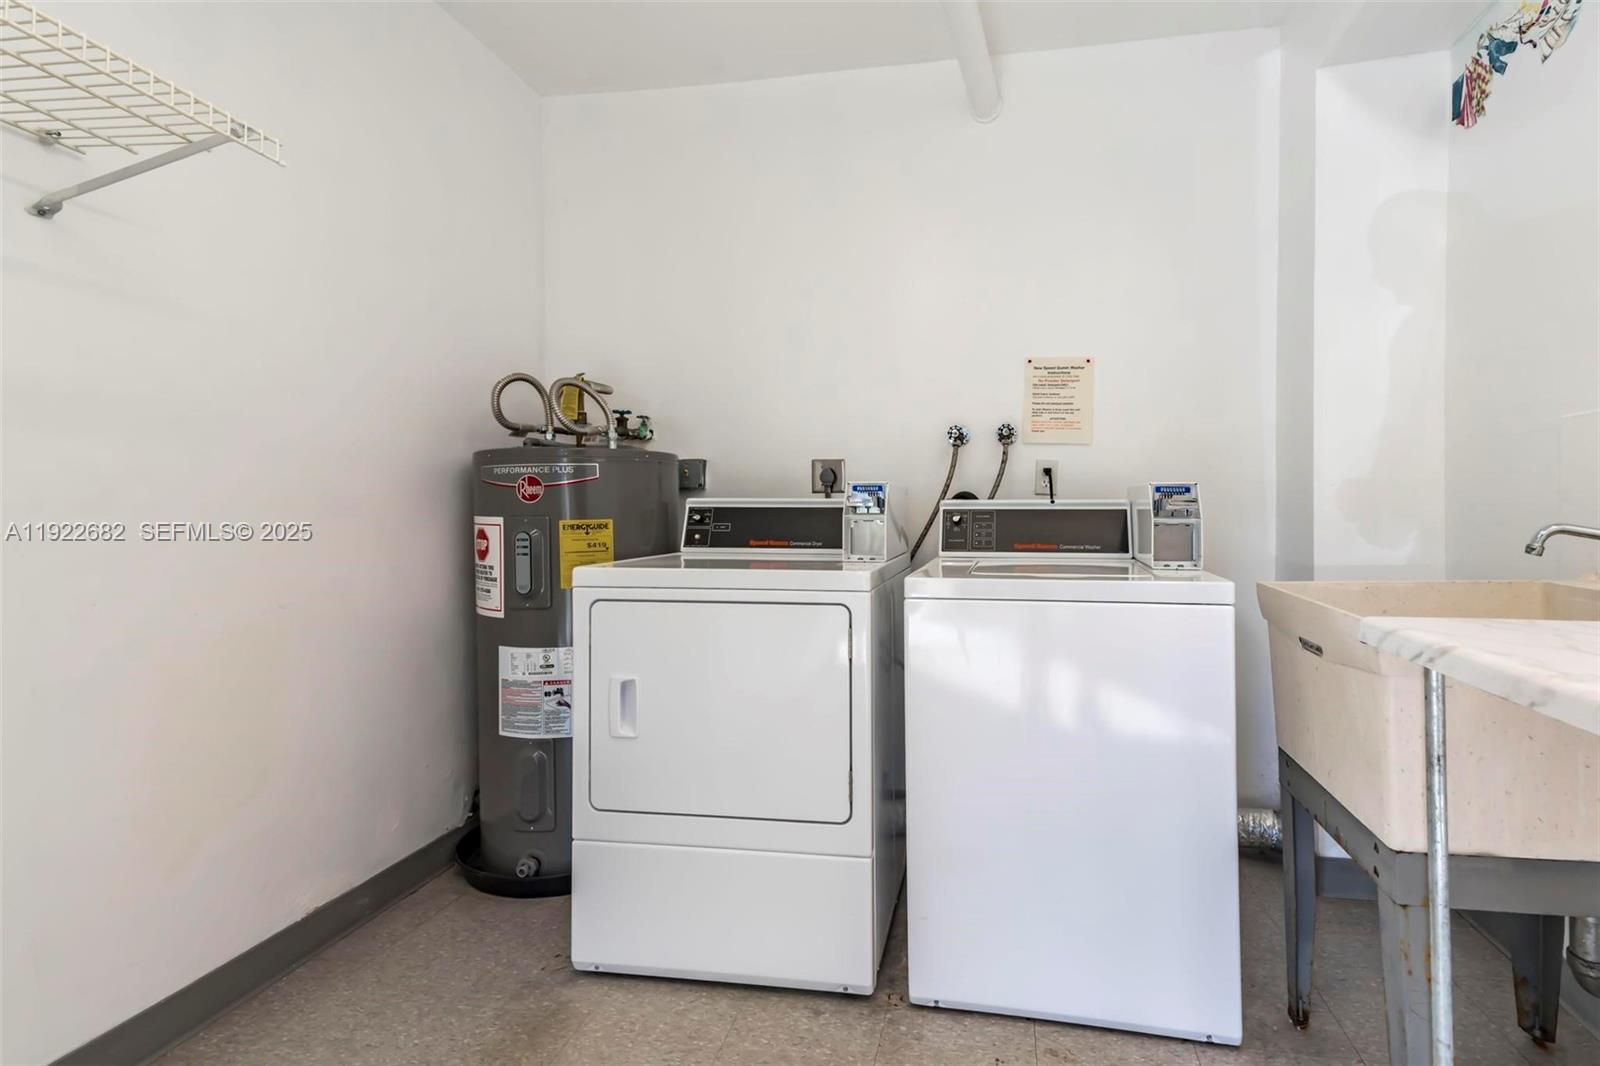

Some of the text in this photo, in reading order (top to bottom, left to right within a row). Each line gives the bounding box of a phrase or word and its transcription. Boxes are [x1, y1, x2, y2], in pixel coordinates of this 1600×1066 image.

[493, 466, 574, 475] PERFORMANCE PLUS
[519, 475, 542, 498] Rheem
